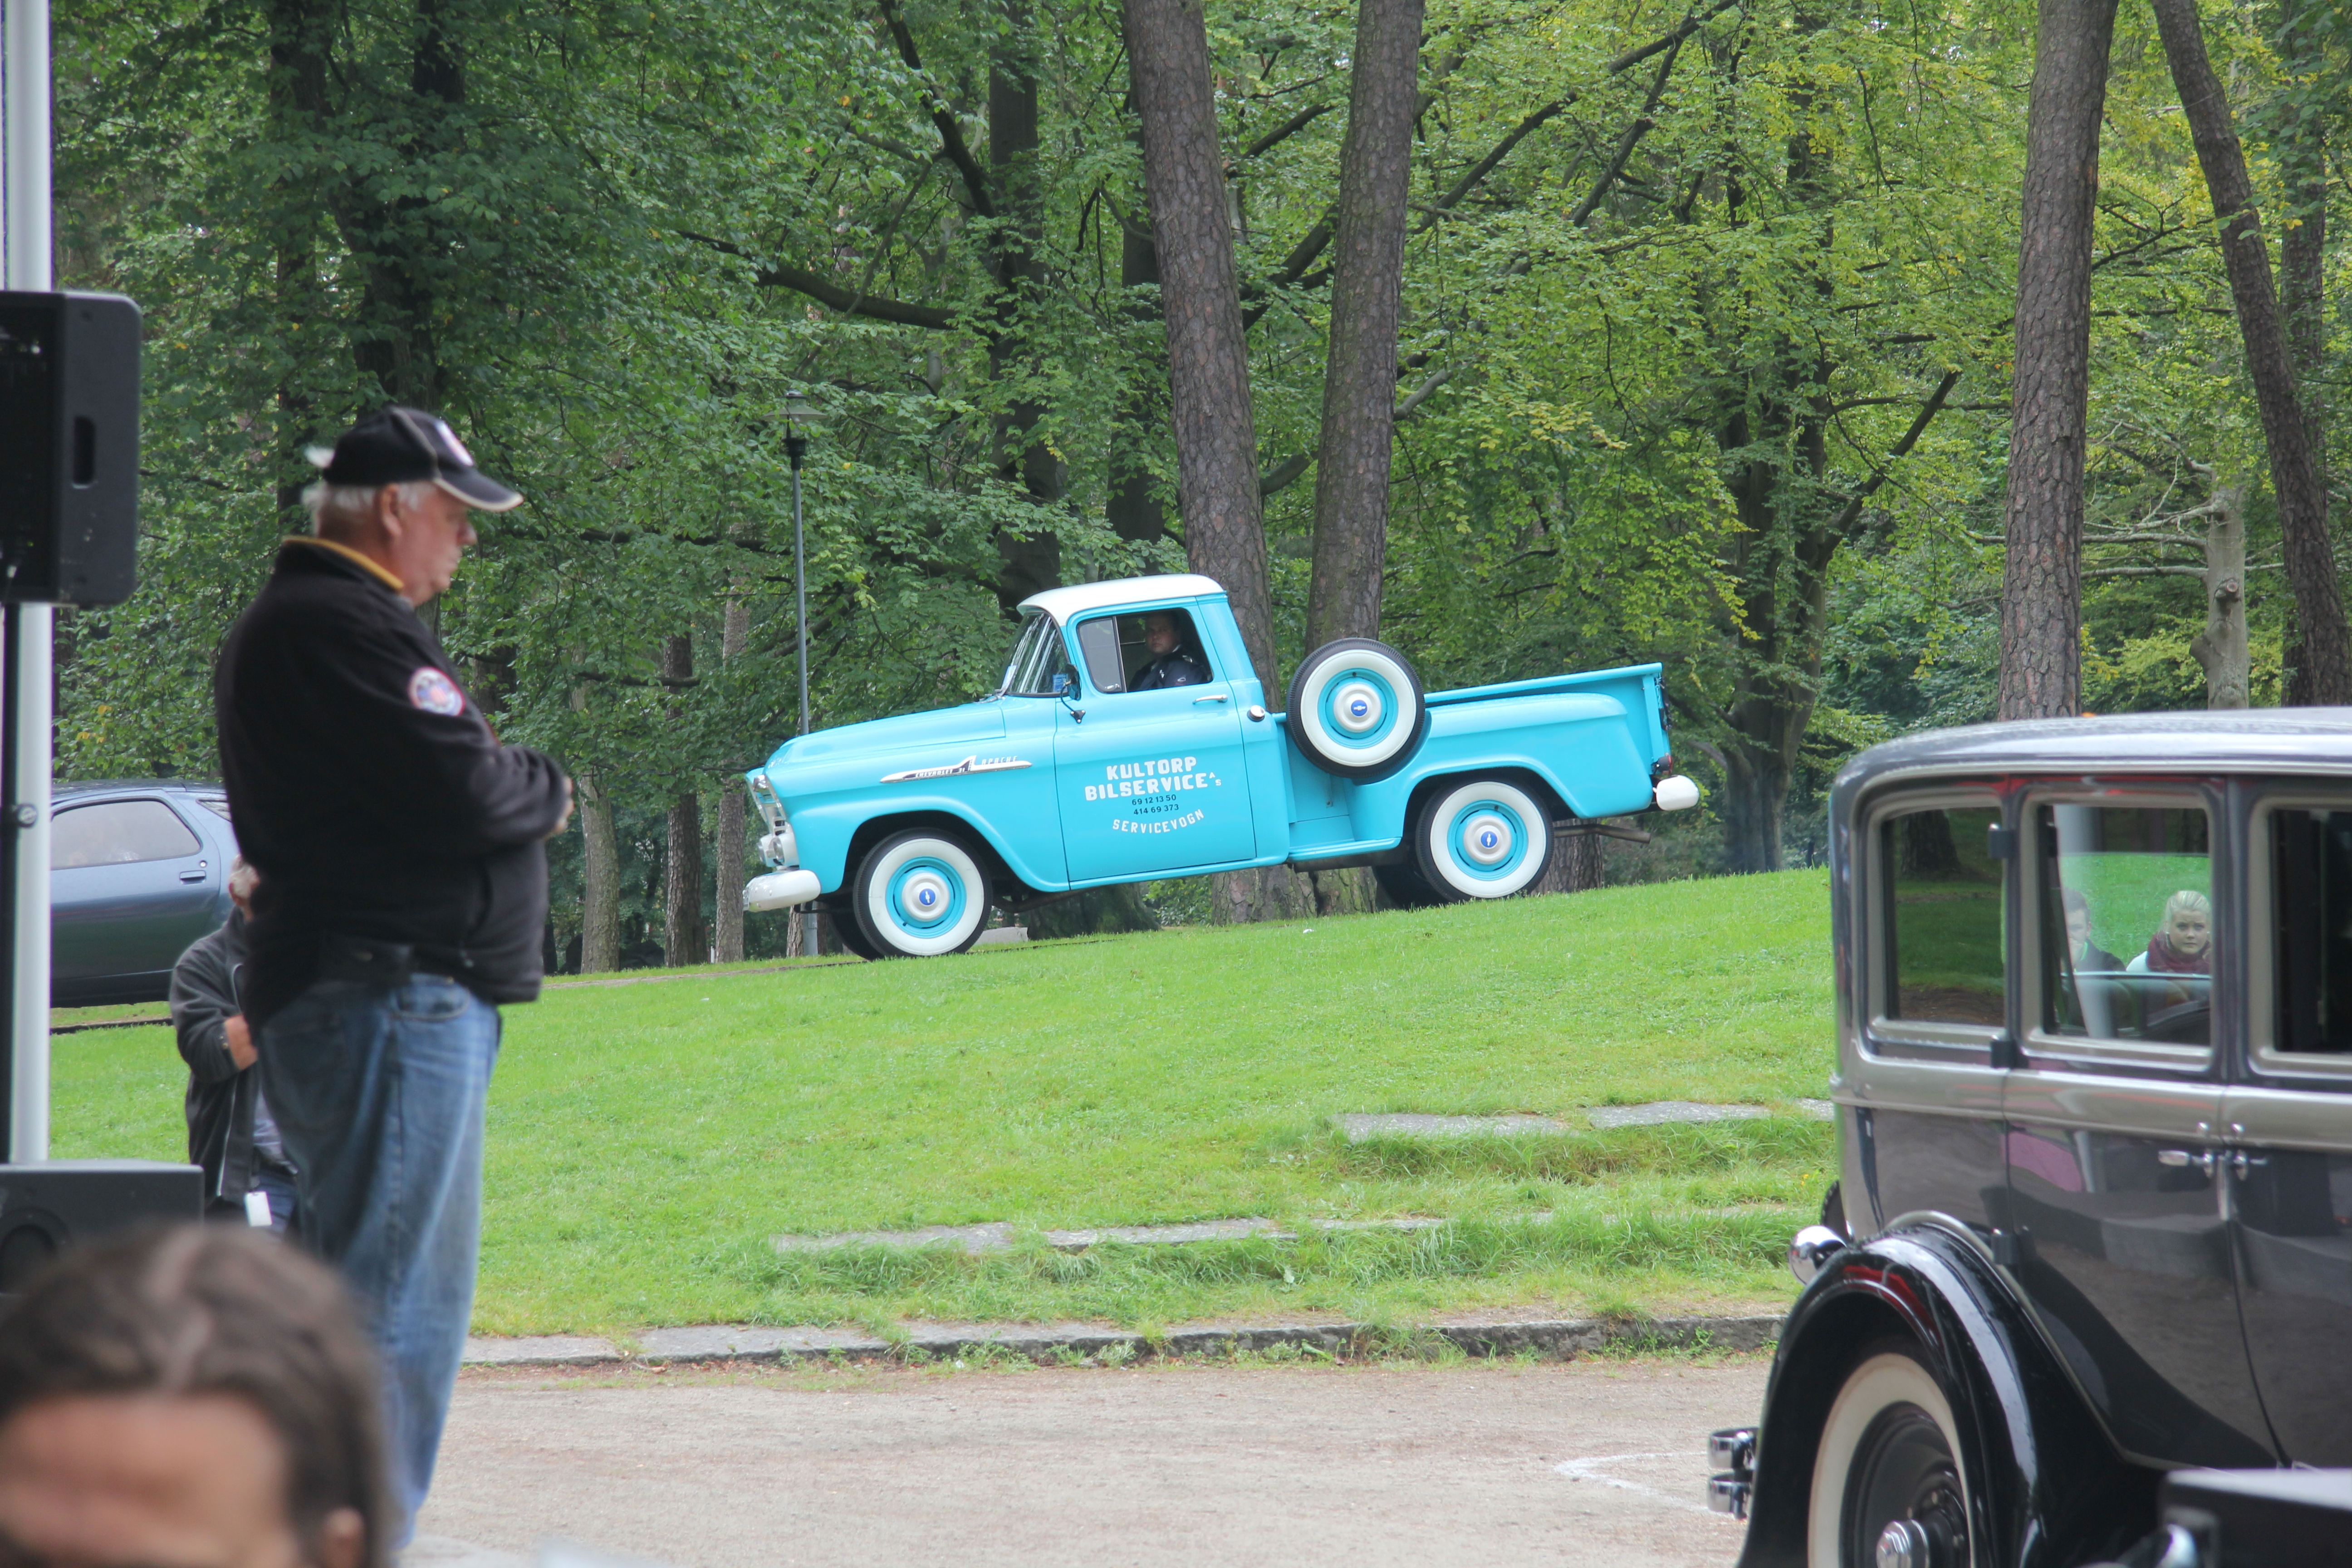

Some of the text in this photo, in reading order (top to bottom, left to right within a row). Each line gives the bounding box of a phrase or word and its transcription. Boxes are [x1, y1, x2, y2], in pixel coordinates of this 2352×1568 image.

[982, 755, 1017, 765] APACHE
[1106, 756, 1197, 780] KULTORP
[1085, 773, 1208, 801] BILSERVICE
[1112, 809, 1204, 833] SERVICEVOGN
